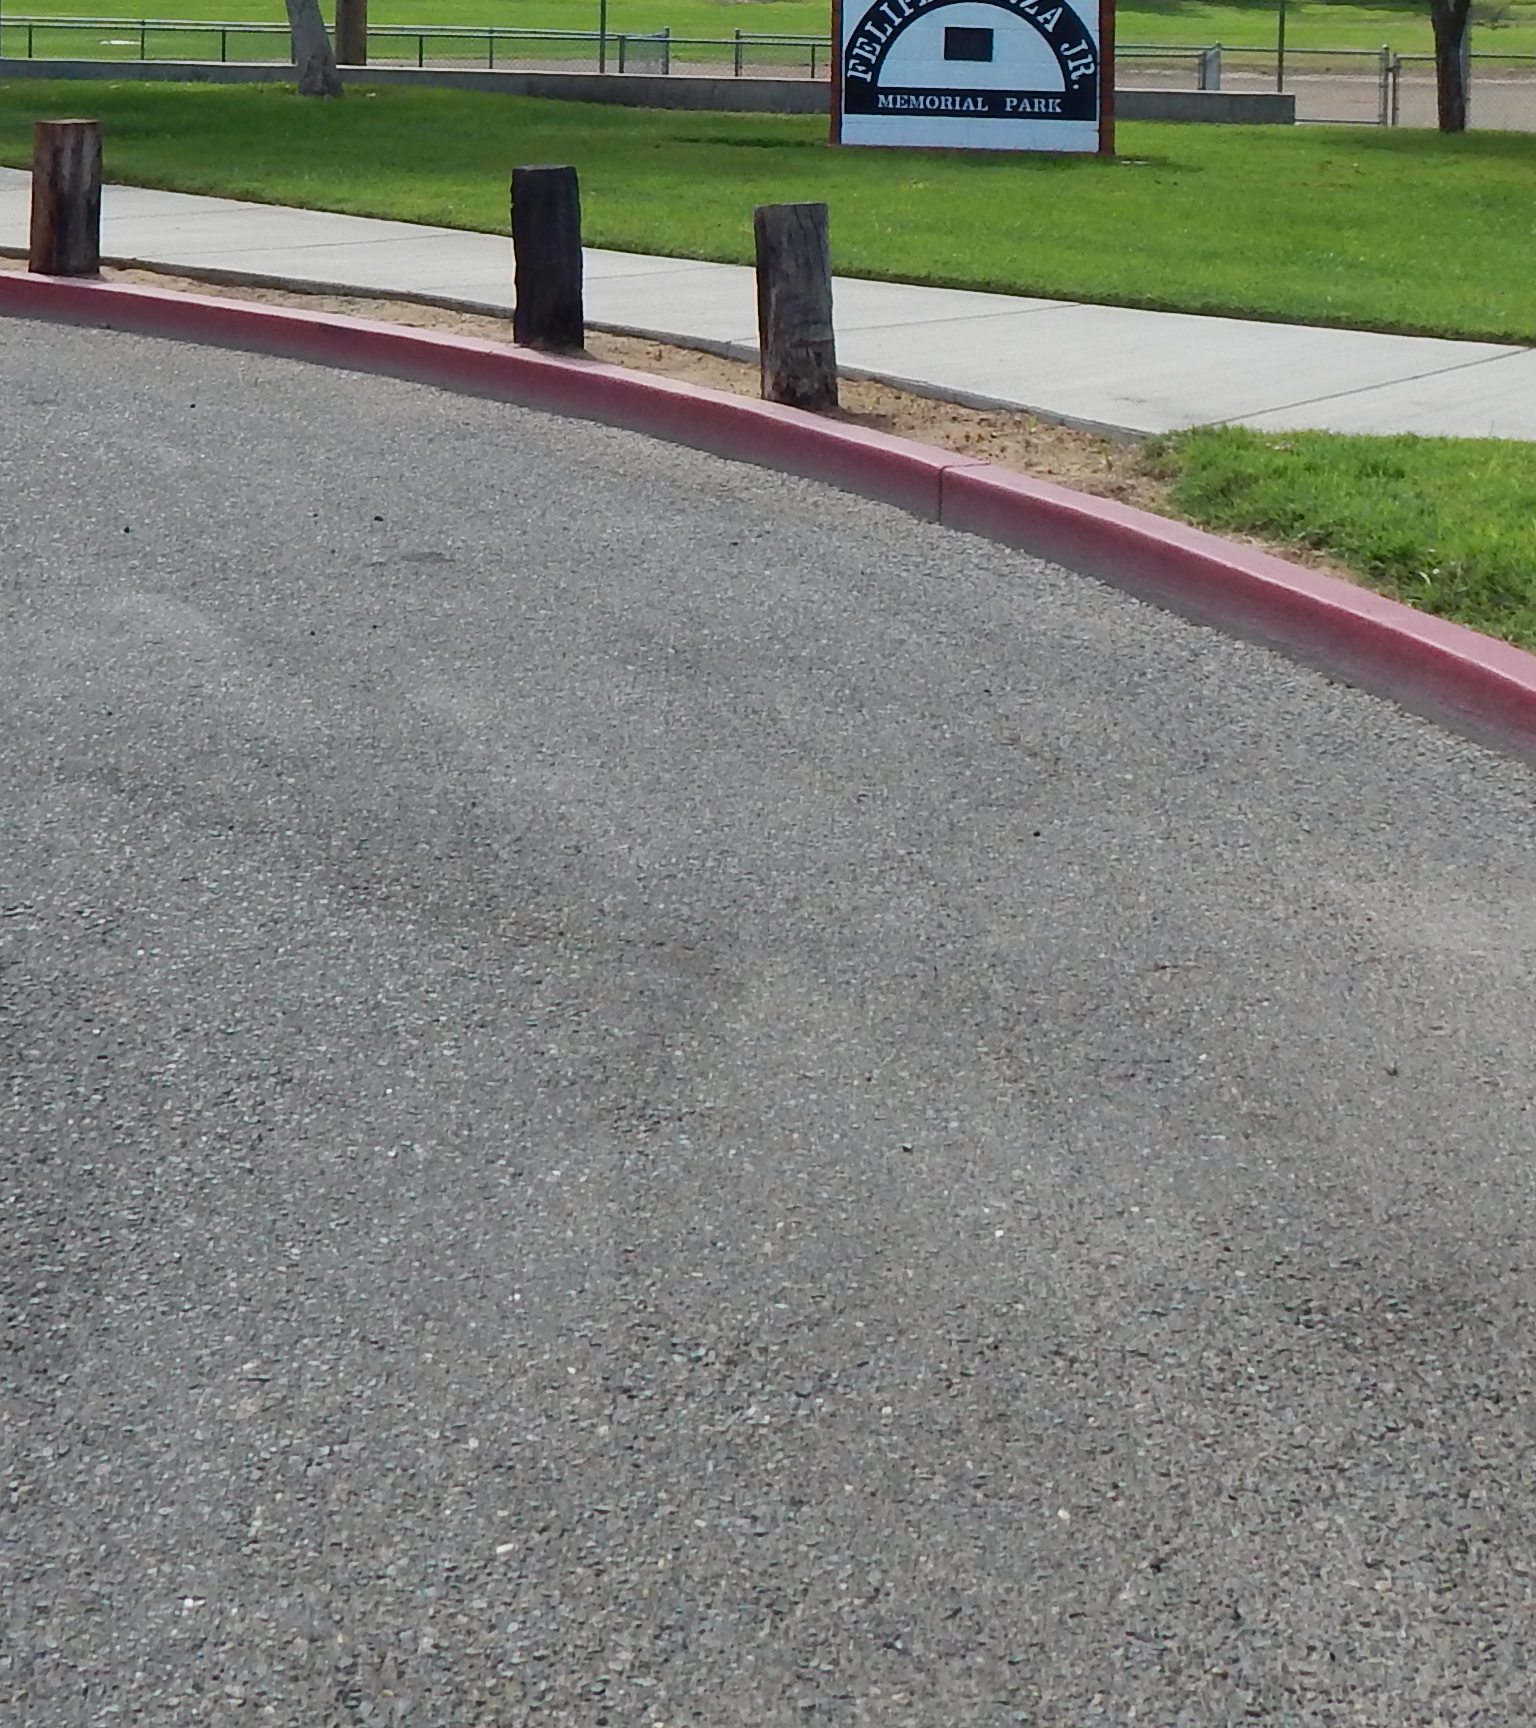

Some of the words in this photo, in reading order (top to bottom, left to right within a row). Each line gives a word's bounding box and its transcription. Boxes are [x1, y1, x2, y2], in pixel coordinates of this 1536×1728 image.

[1061, 39, 1095, 89] JR.
[877, 94, 989, 113] MEMORIAL
[1004, 98, 1063, 114] PARK
